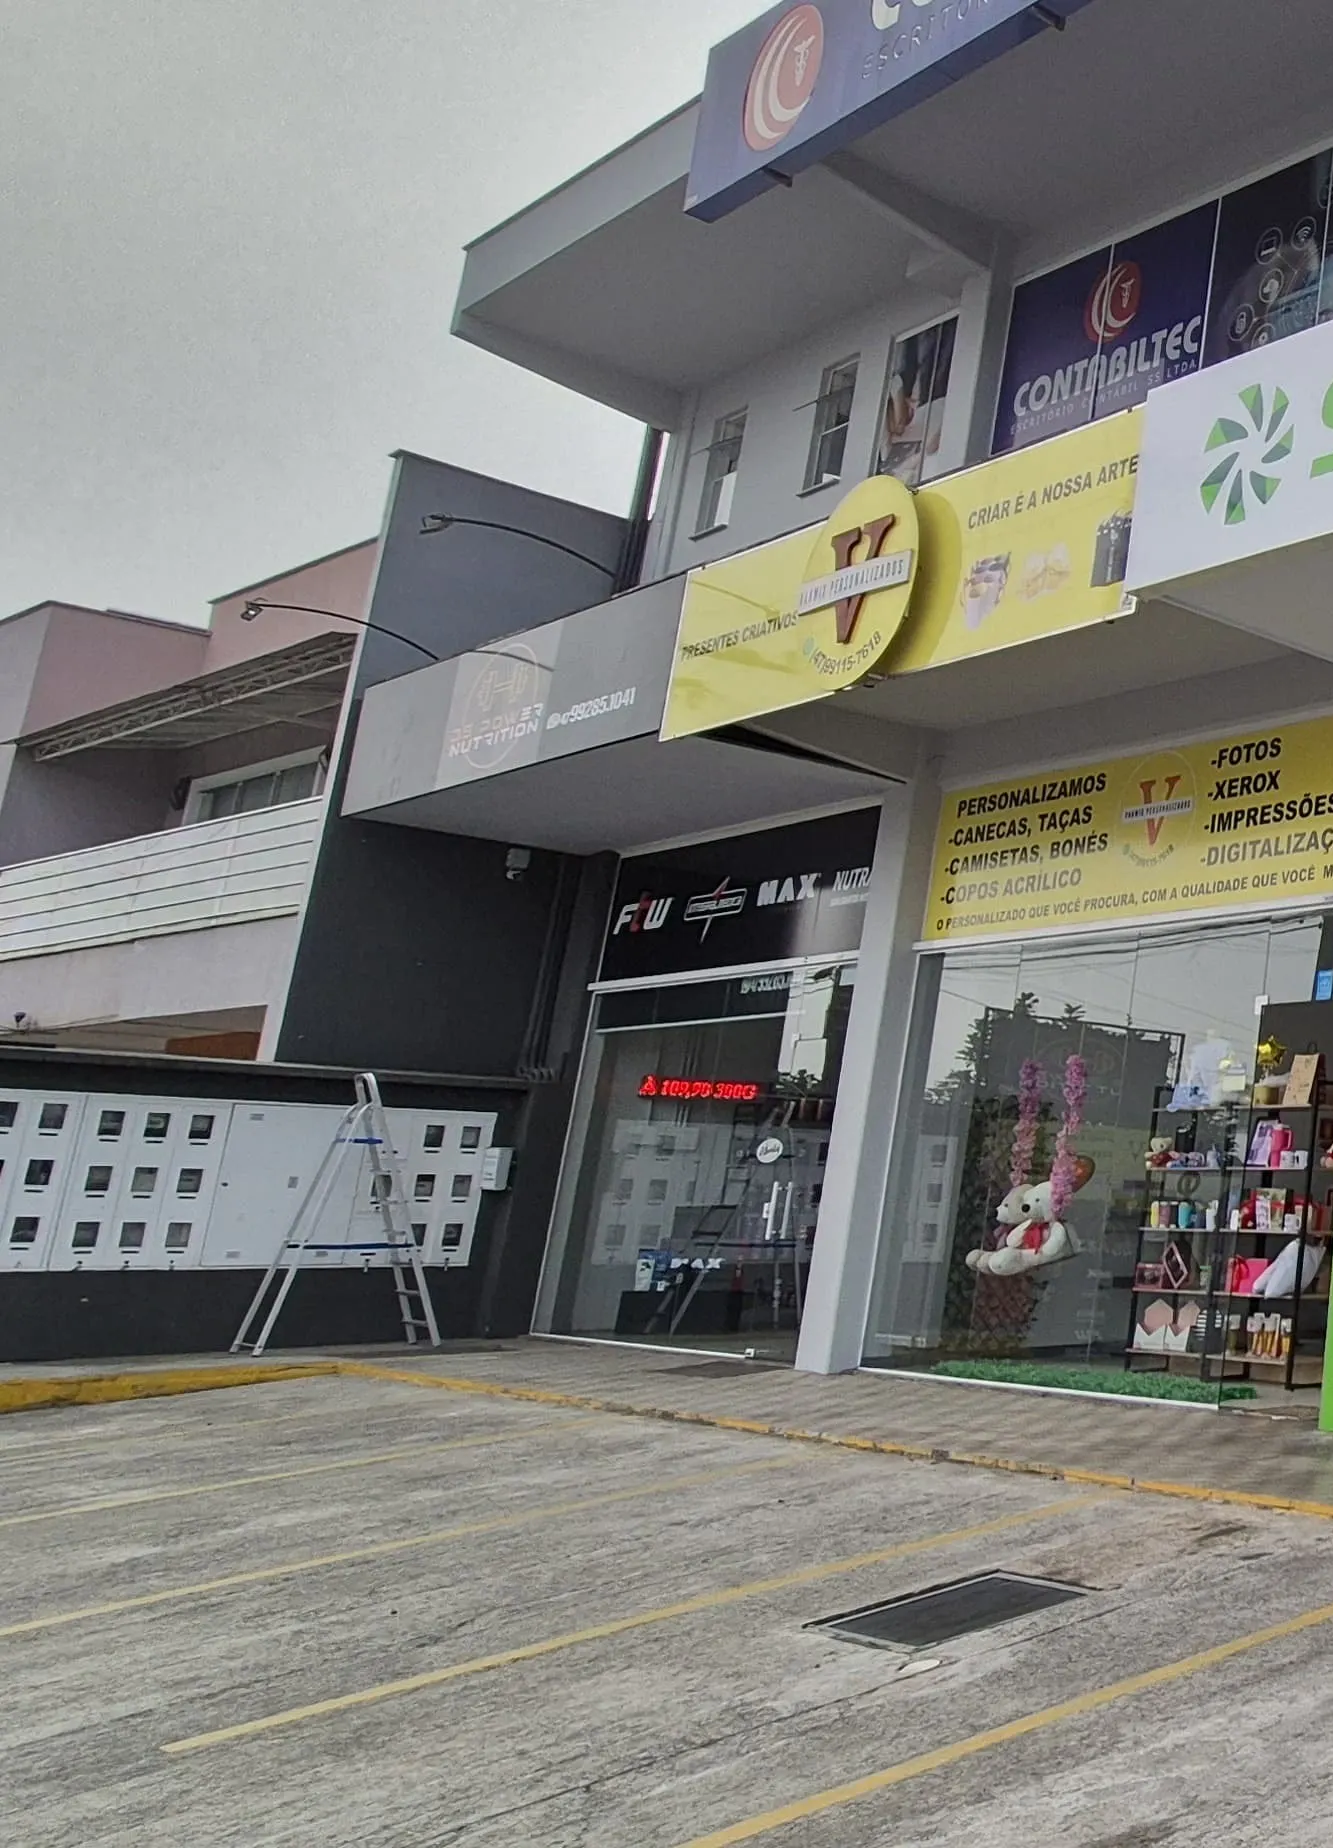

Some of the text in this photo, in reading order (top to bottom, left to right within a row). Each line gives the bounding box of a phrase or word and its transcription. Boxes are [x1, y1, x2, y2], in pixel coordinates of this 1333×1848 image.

[1013, 315, 1202, 416] CONTABILTEC
[968, 453, 1140, 529] CRIAR É A NOSSA ARTE
[831, 513, 896, 644] V
[681, 610, 799, 662] PRESENTES CRIATIVOS
[448, 718, 540, 757] NUTRITION
[1210, 737, 1282, 769] -FOTOS
[957, 773, 1107, 818] PERSONALIZAMOS
[1207, 770, 1281, 801] -XEROX
[948, 805, 1093, 847] -CANECAS, TAÇAS
[944, 844, 1043, 875] -CAMISETAS,
[1050, 830, 1109, 860] BONÉS
[757, 873, 817, 907] MAX
[936, 918, 944, 931] O
[945, 908, 1026, 930] PERSONALIZADO
[1028, 904, 1050, 918] QUE
[1083, 893, 1139, 913] PROCURA,
[1142, 888, 1167, 904] COM
[1170, 886, 1178, 900] A
[1181, 877, 1248, 898] QUALIDADE
[1252, 873, 1277, 889] QUE
[940, 868, 1082, 905] -COPOS ACRÍLICO
